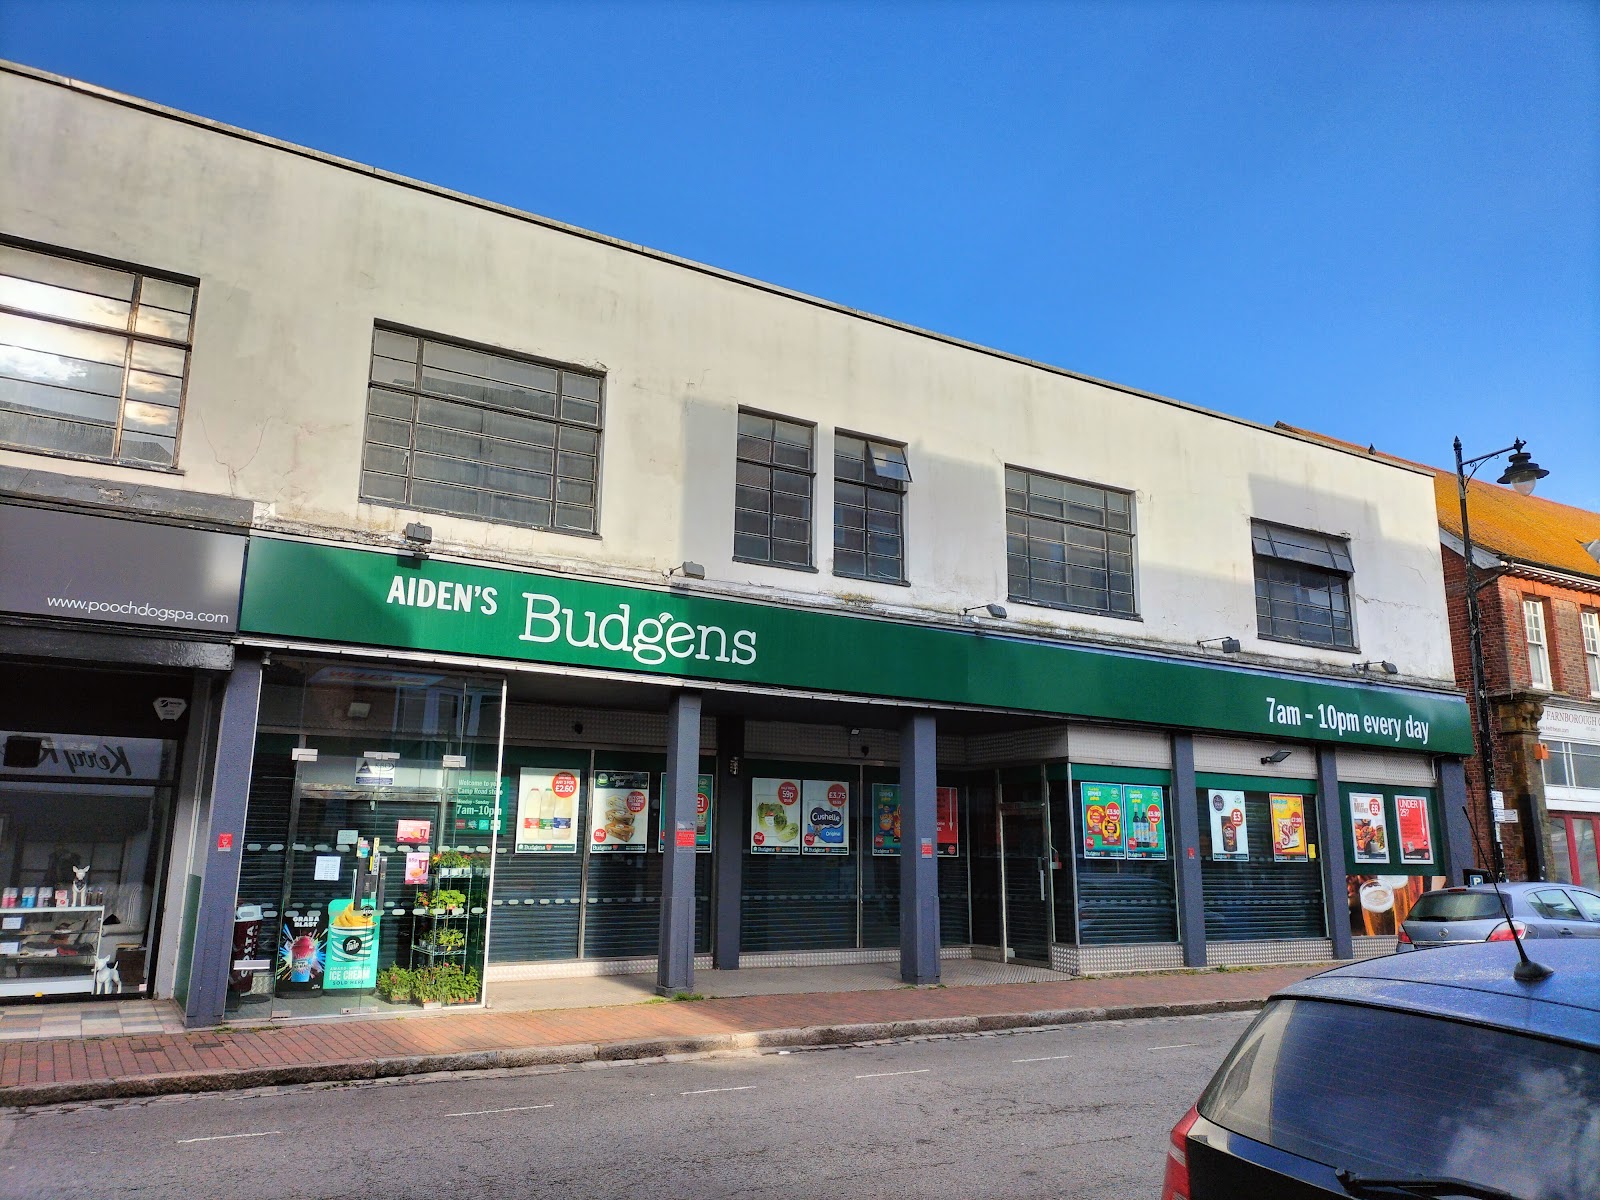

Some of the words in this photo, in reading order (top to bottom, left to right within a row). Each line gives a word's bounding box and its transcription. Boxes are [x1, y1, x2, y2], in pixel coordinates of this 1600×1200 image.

[386, 575, 498, 615] AIDEN'S
[47, 597, 229, 623] www.poochdogspa.com
[518, 592, 757, 665] Budgens
[1266, 697, 1301, 726] 7am
[1317, 703, 1360, 736] 10pm
[1363, 714, 1401, 742] every
[1405, 715, 1429, 744] day
[1546, 710, 1597, 726] FARNBOROUGH
[490, 781, 502, 789] yor
[555, 785, 574, 793] £2.60
[782, 790, 793, 799] 59p
[828, 791, 846, 799] £3.75
[1400, 799, 1418, 809] UNDER
[811, 812, 840, 822] Cushelle
[1233, 811, 1240, 821] £3
[1400, 808, 1409, 817] 25?
[329, 970, 341, 980] ICE
[343, 968, 370, 980] CREAM
